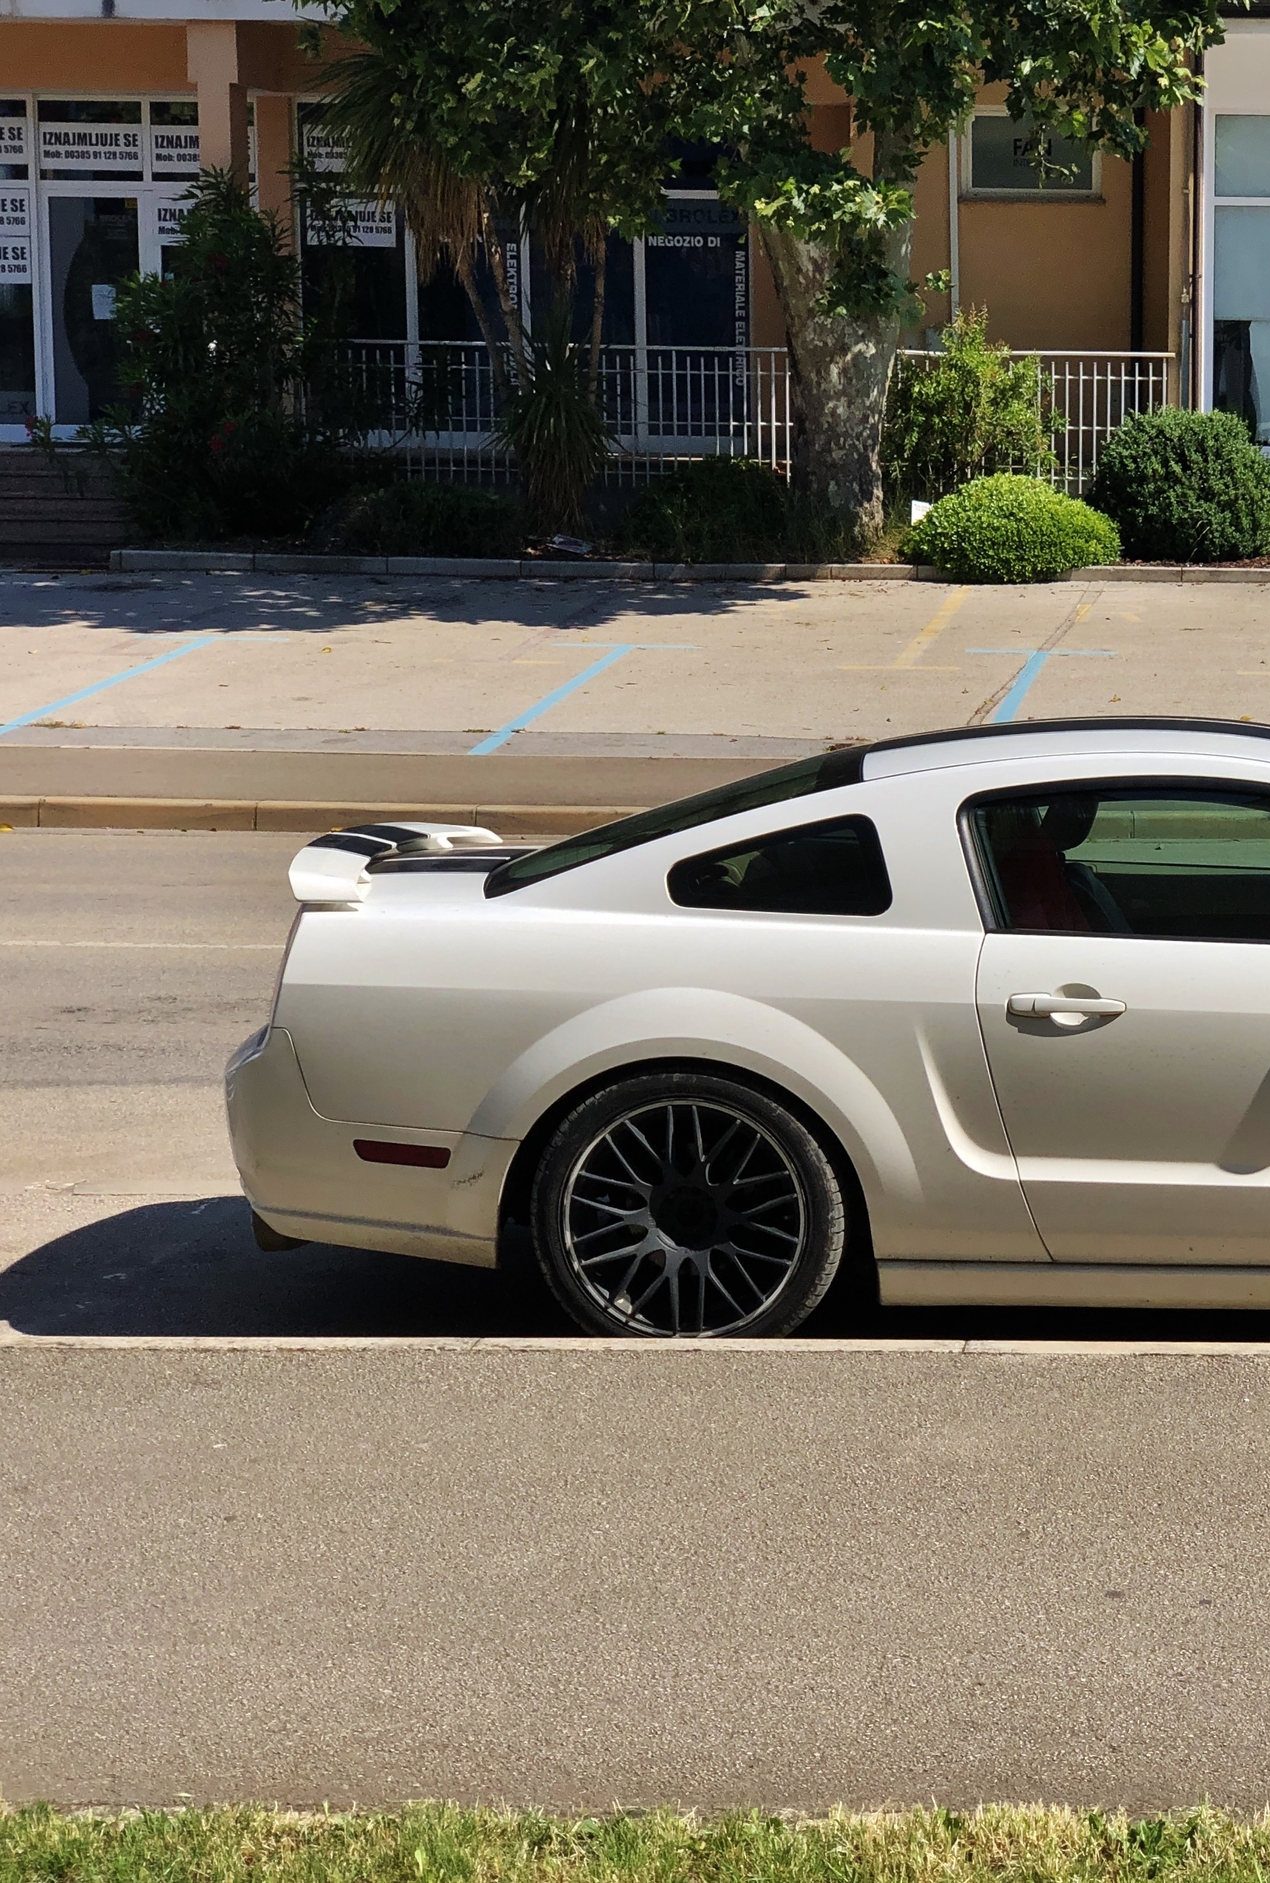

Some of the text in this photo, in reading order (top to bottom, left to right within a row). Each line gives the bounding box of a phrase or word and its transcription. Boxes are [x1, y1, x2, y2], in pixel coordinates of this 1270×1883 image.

[8, 126, 23, 142] SE
[42, 131, 139, 148] IZNAJMLJUJE SE
[155, 134, 200, 149] IZNAJM
[4, 144, 24, 154] 5766
[43, 149, 139, 161] Mob: 00385 91 128 5766
[155, 152, 200, 162] Mob: 0038
[9, 198, 26, 213] SE
[6, 216, 26, 226] 5766
[647, 235, 720, 248] NEGOZIO DI
[11, 246, 27, 261] SE
[8, 264, 28, 274] 5766
[734, 250, 746, 318] MATERIALE
